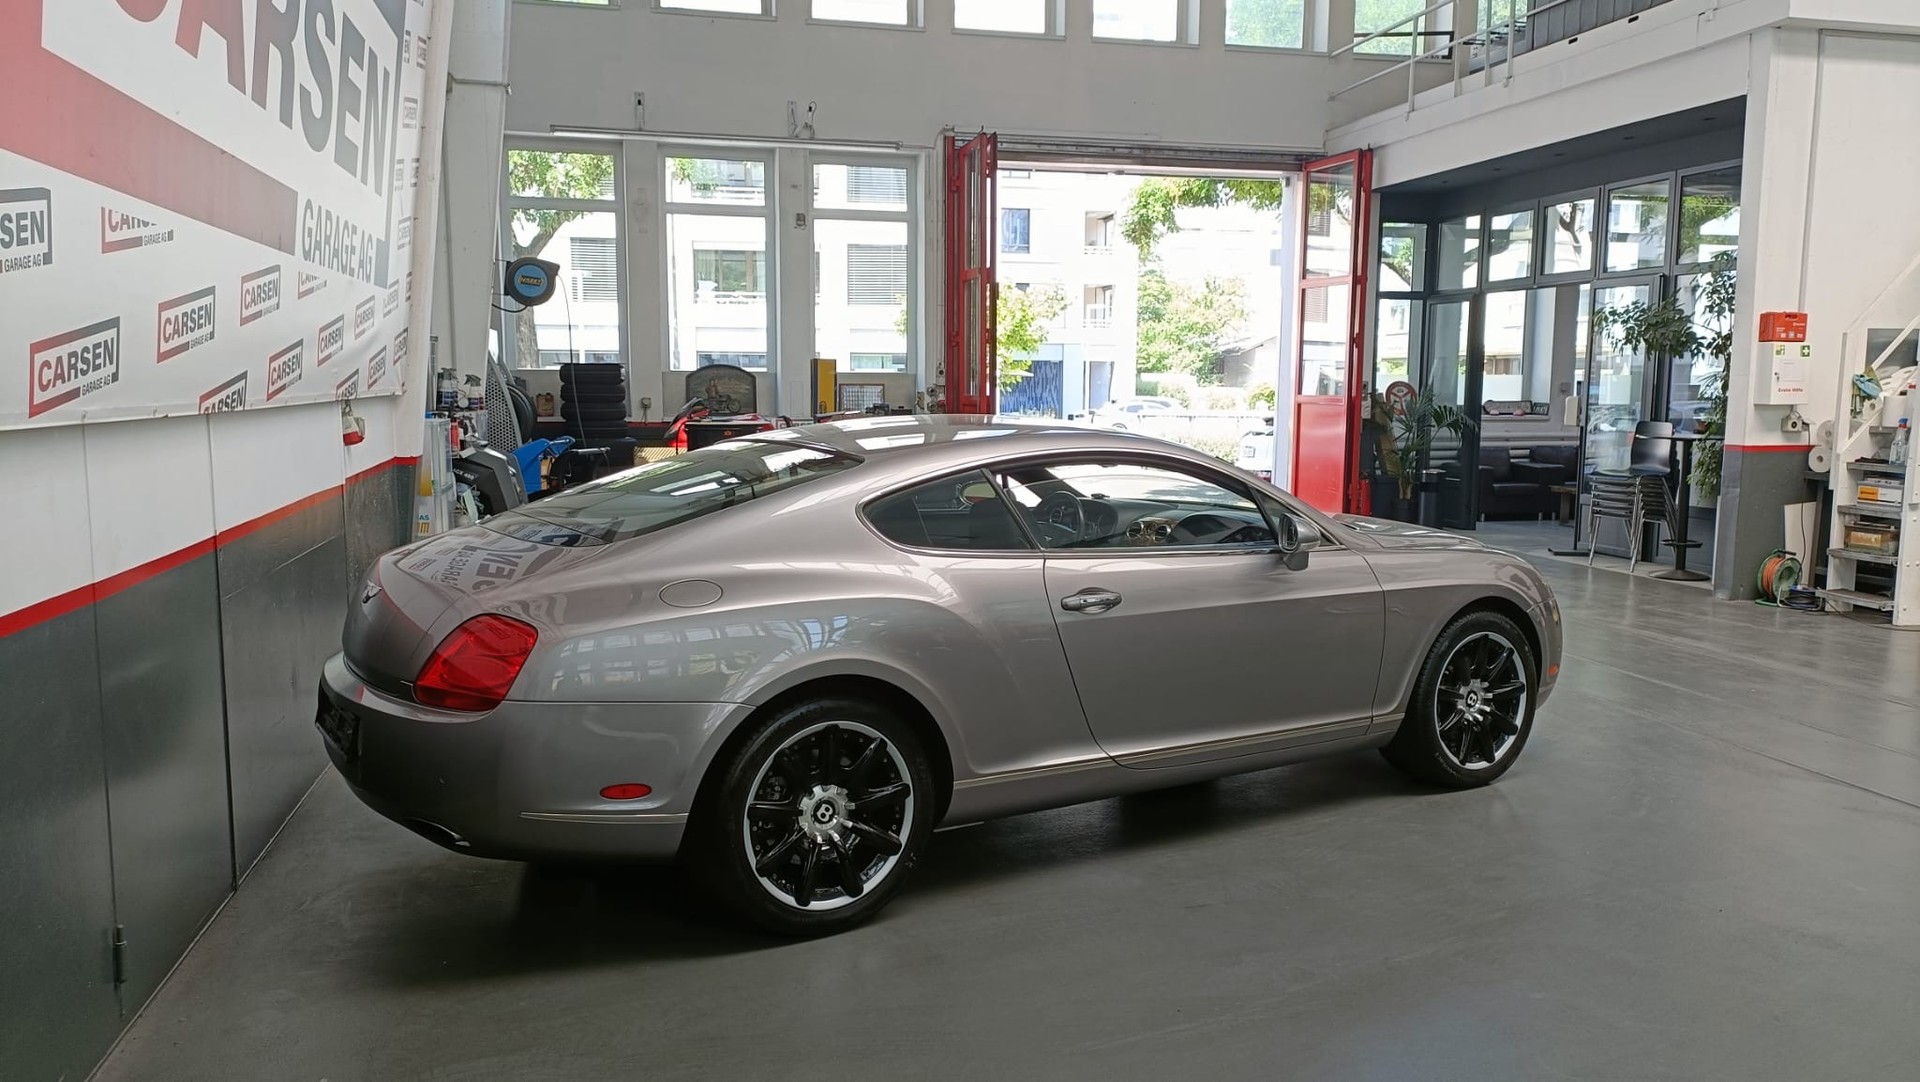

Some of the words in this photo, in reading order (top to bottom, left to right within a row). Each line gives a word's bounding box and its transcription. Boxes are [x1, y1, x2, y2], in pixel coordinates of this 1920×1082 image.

[114, 0, 390, 197] RSEN
[0, 210, 45, 249] SEN
[144, 232, 161, 246] GARAGE
[302, 198, 357, 278] GARAGE
[357, 229, 373, 284] AG
[4, 255, 31, 273] GARAGE
[33, 253, 42, 267] AG
[244, 278, 278, 310] CARSEN
[163, 302, 212, 344] CARSEN
[320, 326, 343, 354] CARSEN
[38, 337, 114, 392] CARSEN
[271, 351, 300, 386] CARSEN
[82, 377, 103, 396] GARAGE
[103, 374, 110, 386] AG
